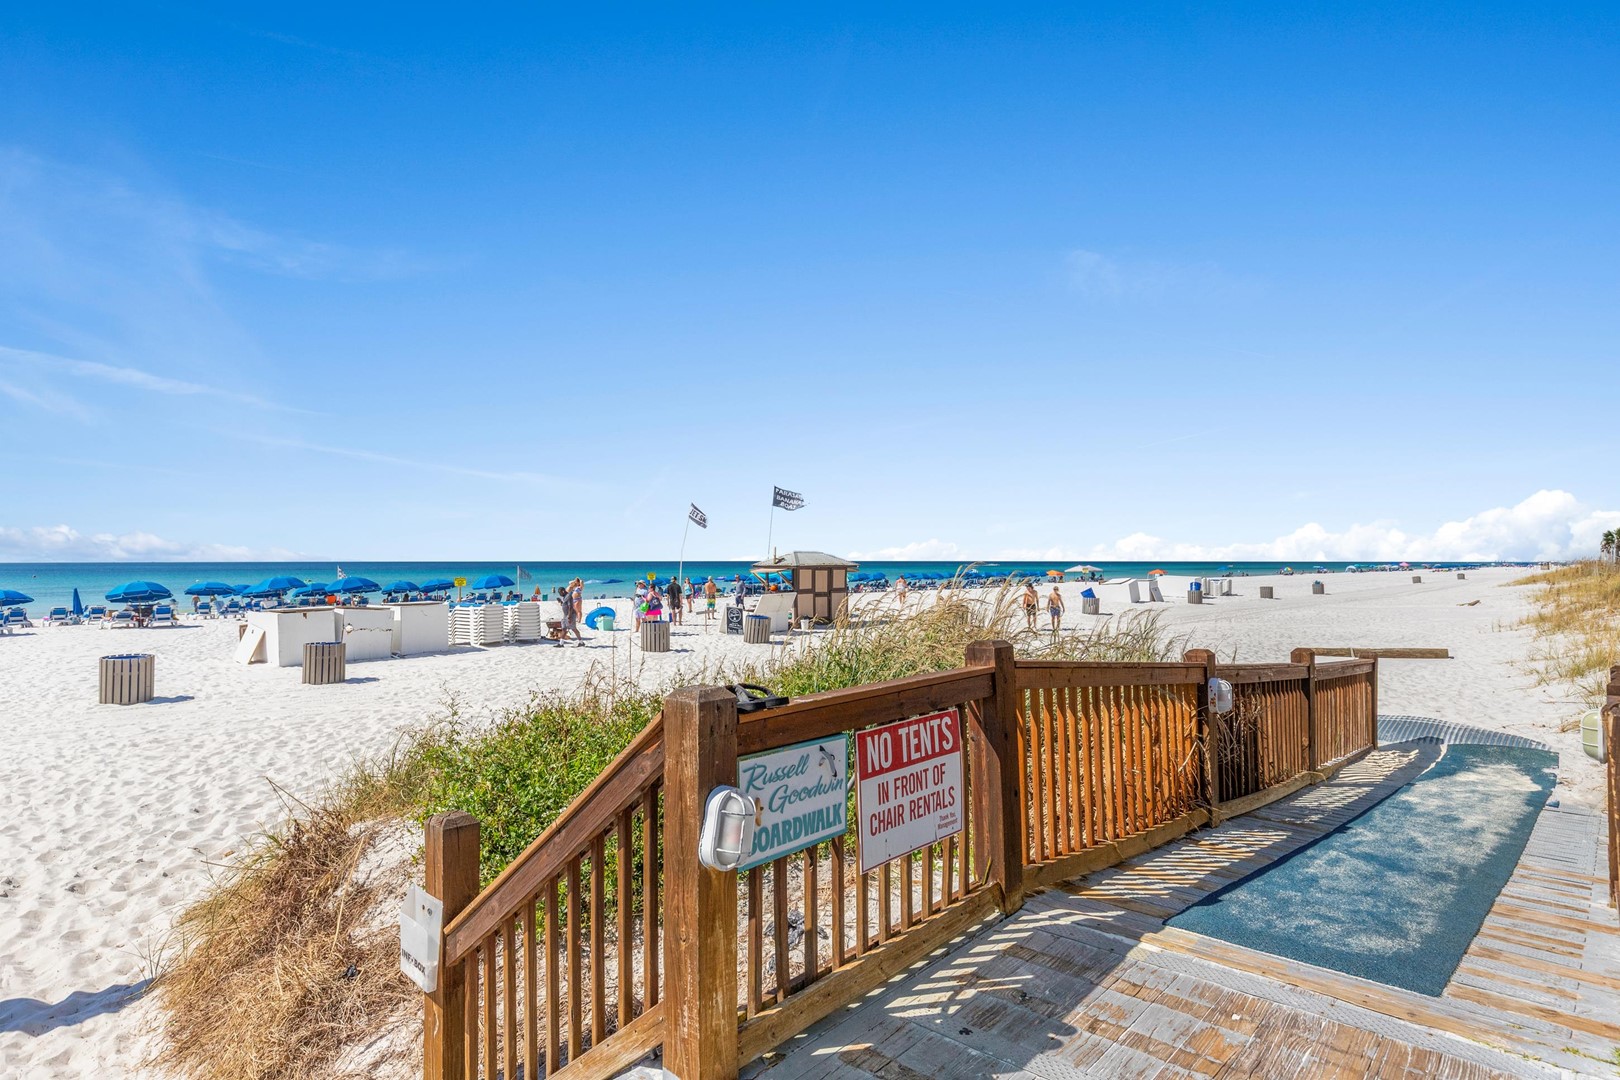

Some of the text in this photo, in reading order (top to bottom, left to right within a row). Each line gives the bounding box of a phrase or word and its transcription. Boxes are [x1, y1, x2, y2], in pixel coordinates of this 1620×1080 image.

[866, 716, 953, 773] NO TENTS
[742, 753, 810, 794] Russell
[768, 775, 844, 814] Goodwin
[878, 763, 946, 806] IN FRONT OF
[870, 786, 955, 836] CHAIR RENTALS
